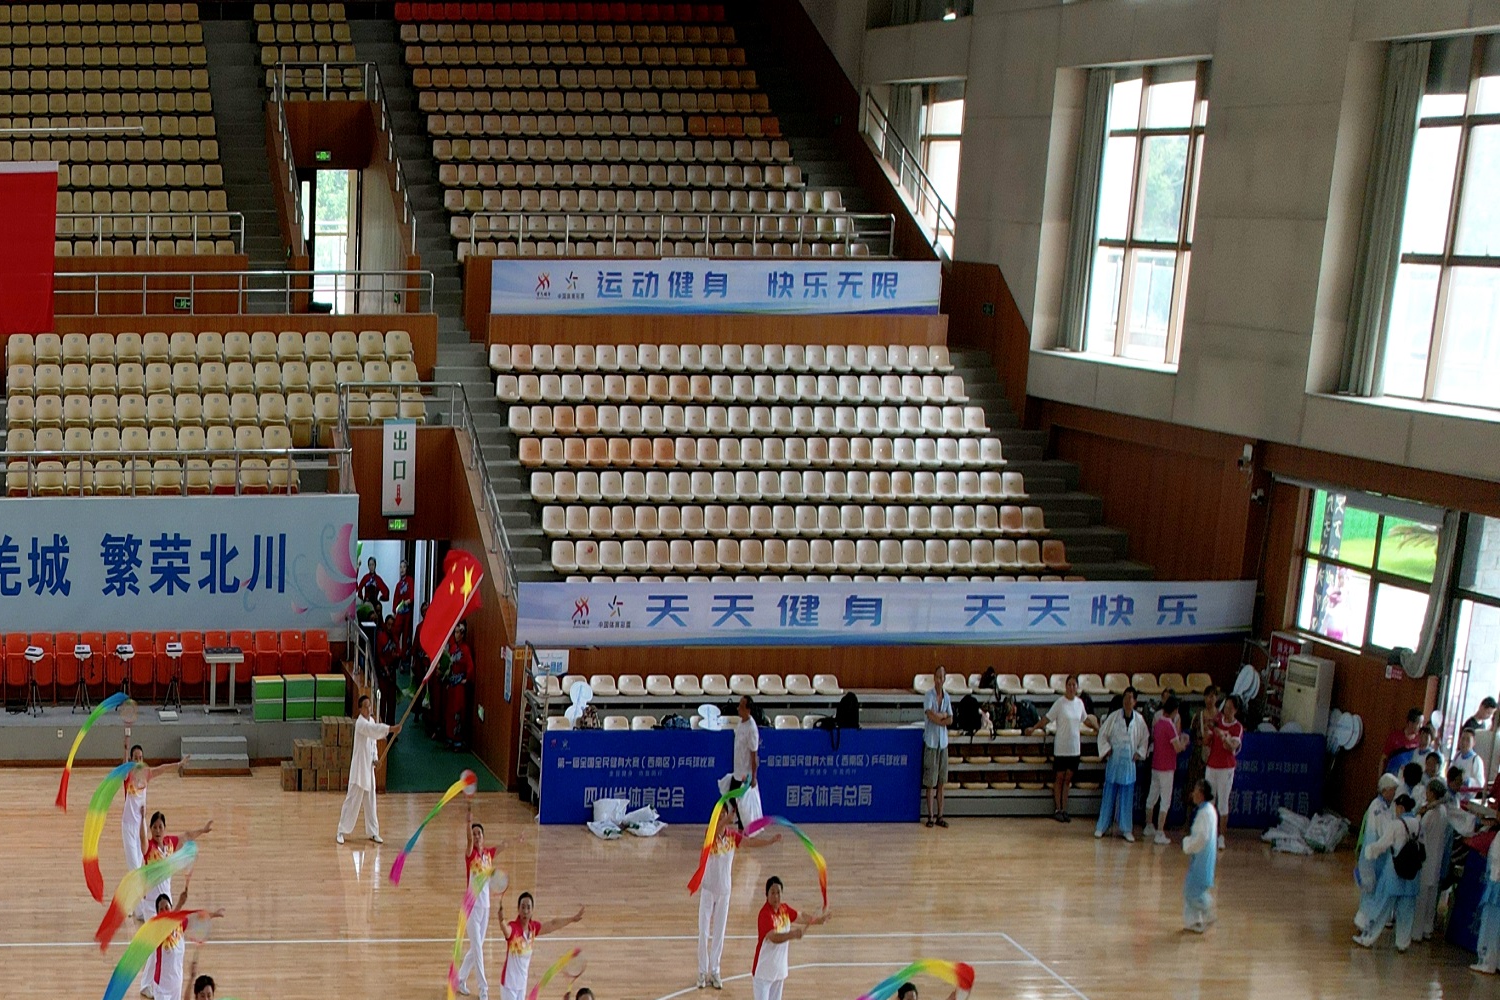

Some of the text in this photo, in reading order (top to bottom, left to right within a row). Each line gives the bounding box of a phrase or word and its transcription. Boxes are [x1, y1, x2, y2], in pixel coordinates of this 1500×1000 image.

[596, 271, 899, 299] 运动健身 快乐无限
[393, 430, 407, 480] 出口
[100, 532, 287, 597] 繁荣北川
[645, 592, 1200, 629] 天天健身 天天快乐
[785, 784, 873, 808] 国家体育总局
